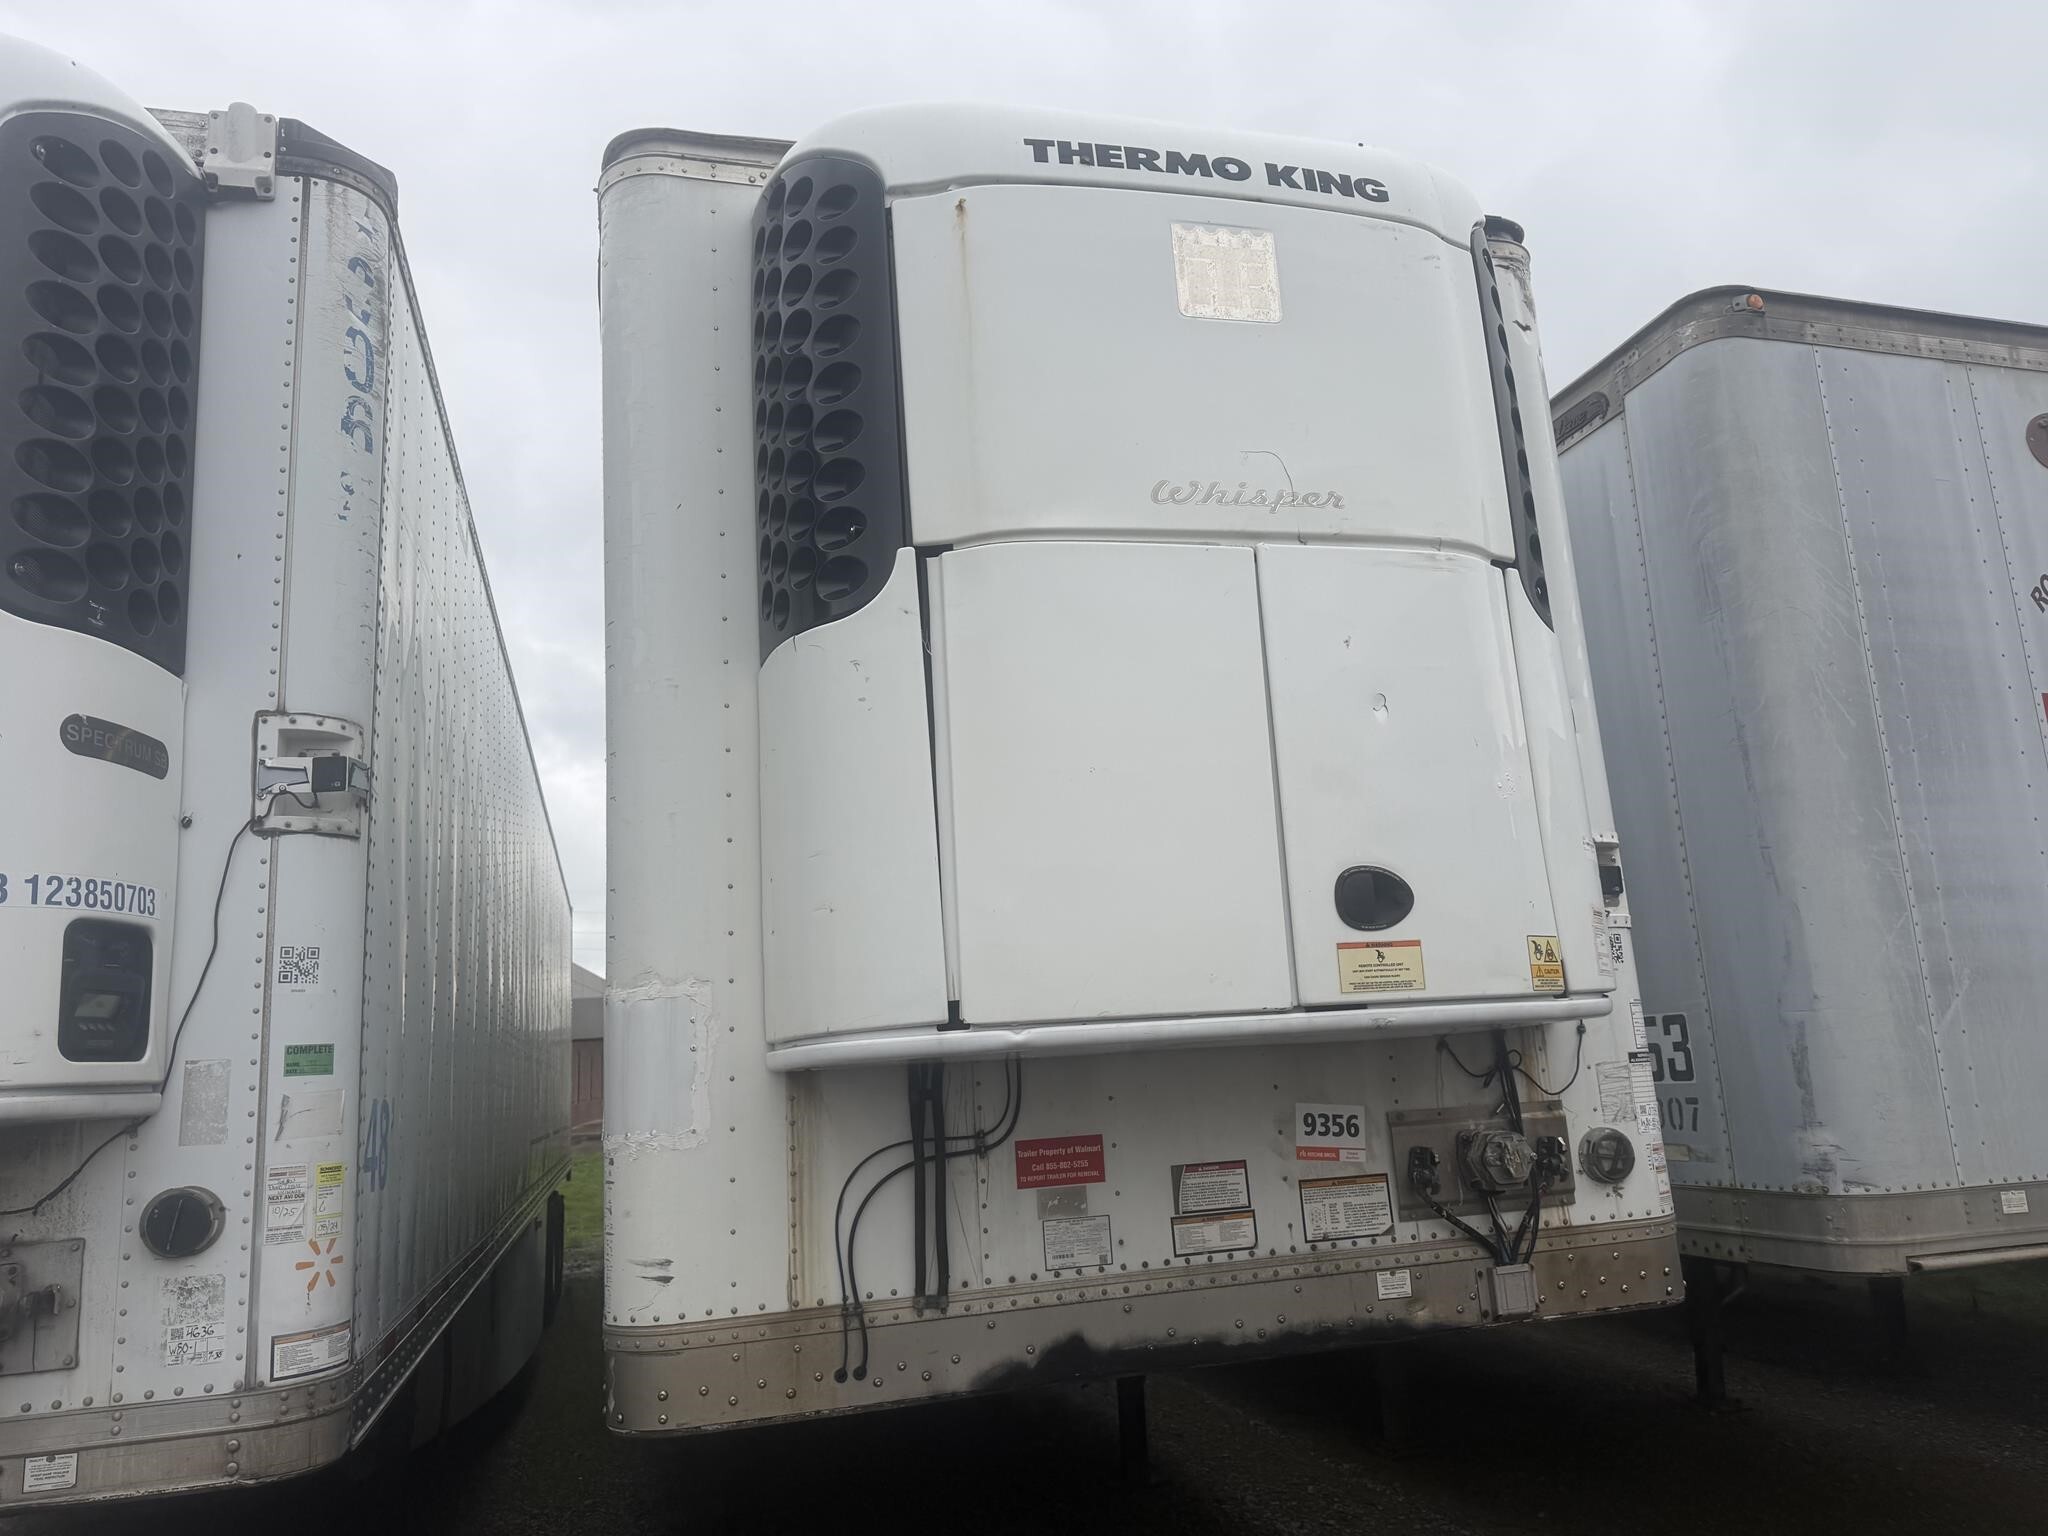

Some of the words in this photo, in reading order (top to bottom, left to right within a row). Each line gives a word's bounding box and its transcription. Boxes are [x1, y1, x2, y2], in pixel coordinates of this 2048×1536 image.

[1024, 138, 1251, 181] THERMO
[1264, 162, 1390, 203] KING
[1151, 480, 1345, 513] Whisper
[24, 874, 156, 916] 123850703
[286, 1044, 334, 1055] COMPLETE
[1303, 1112, 1360, 1138] 9356
[1075, 1144, 1101, 1153] Walmart
[1032, 1162, 1044, 1171] Call
